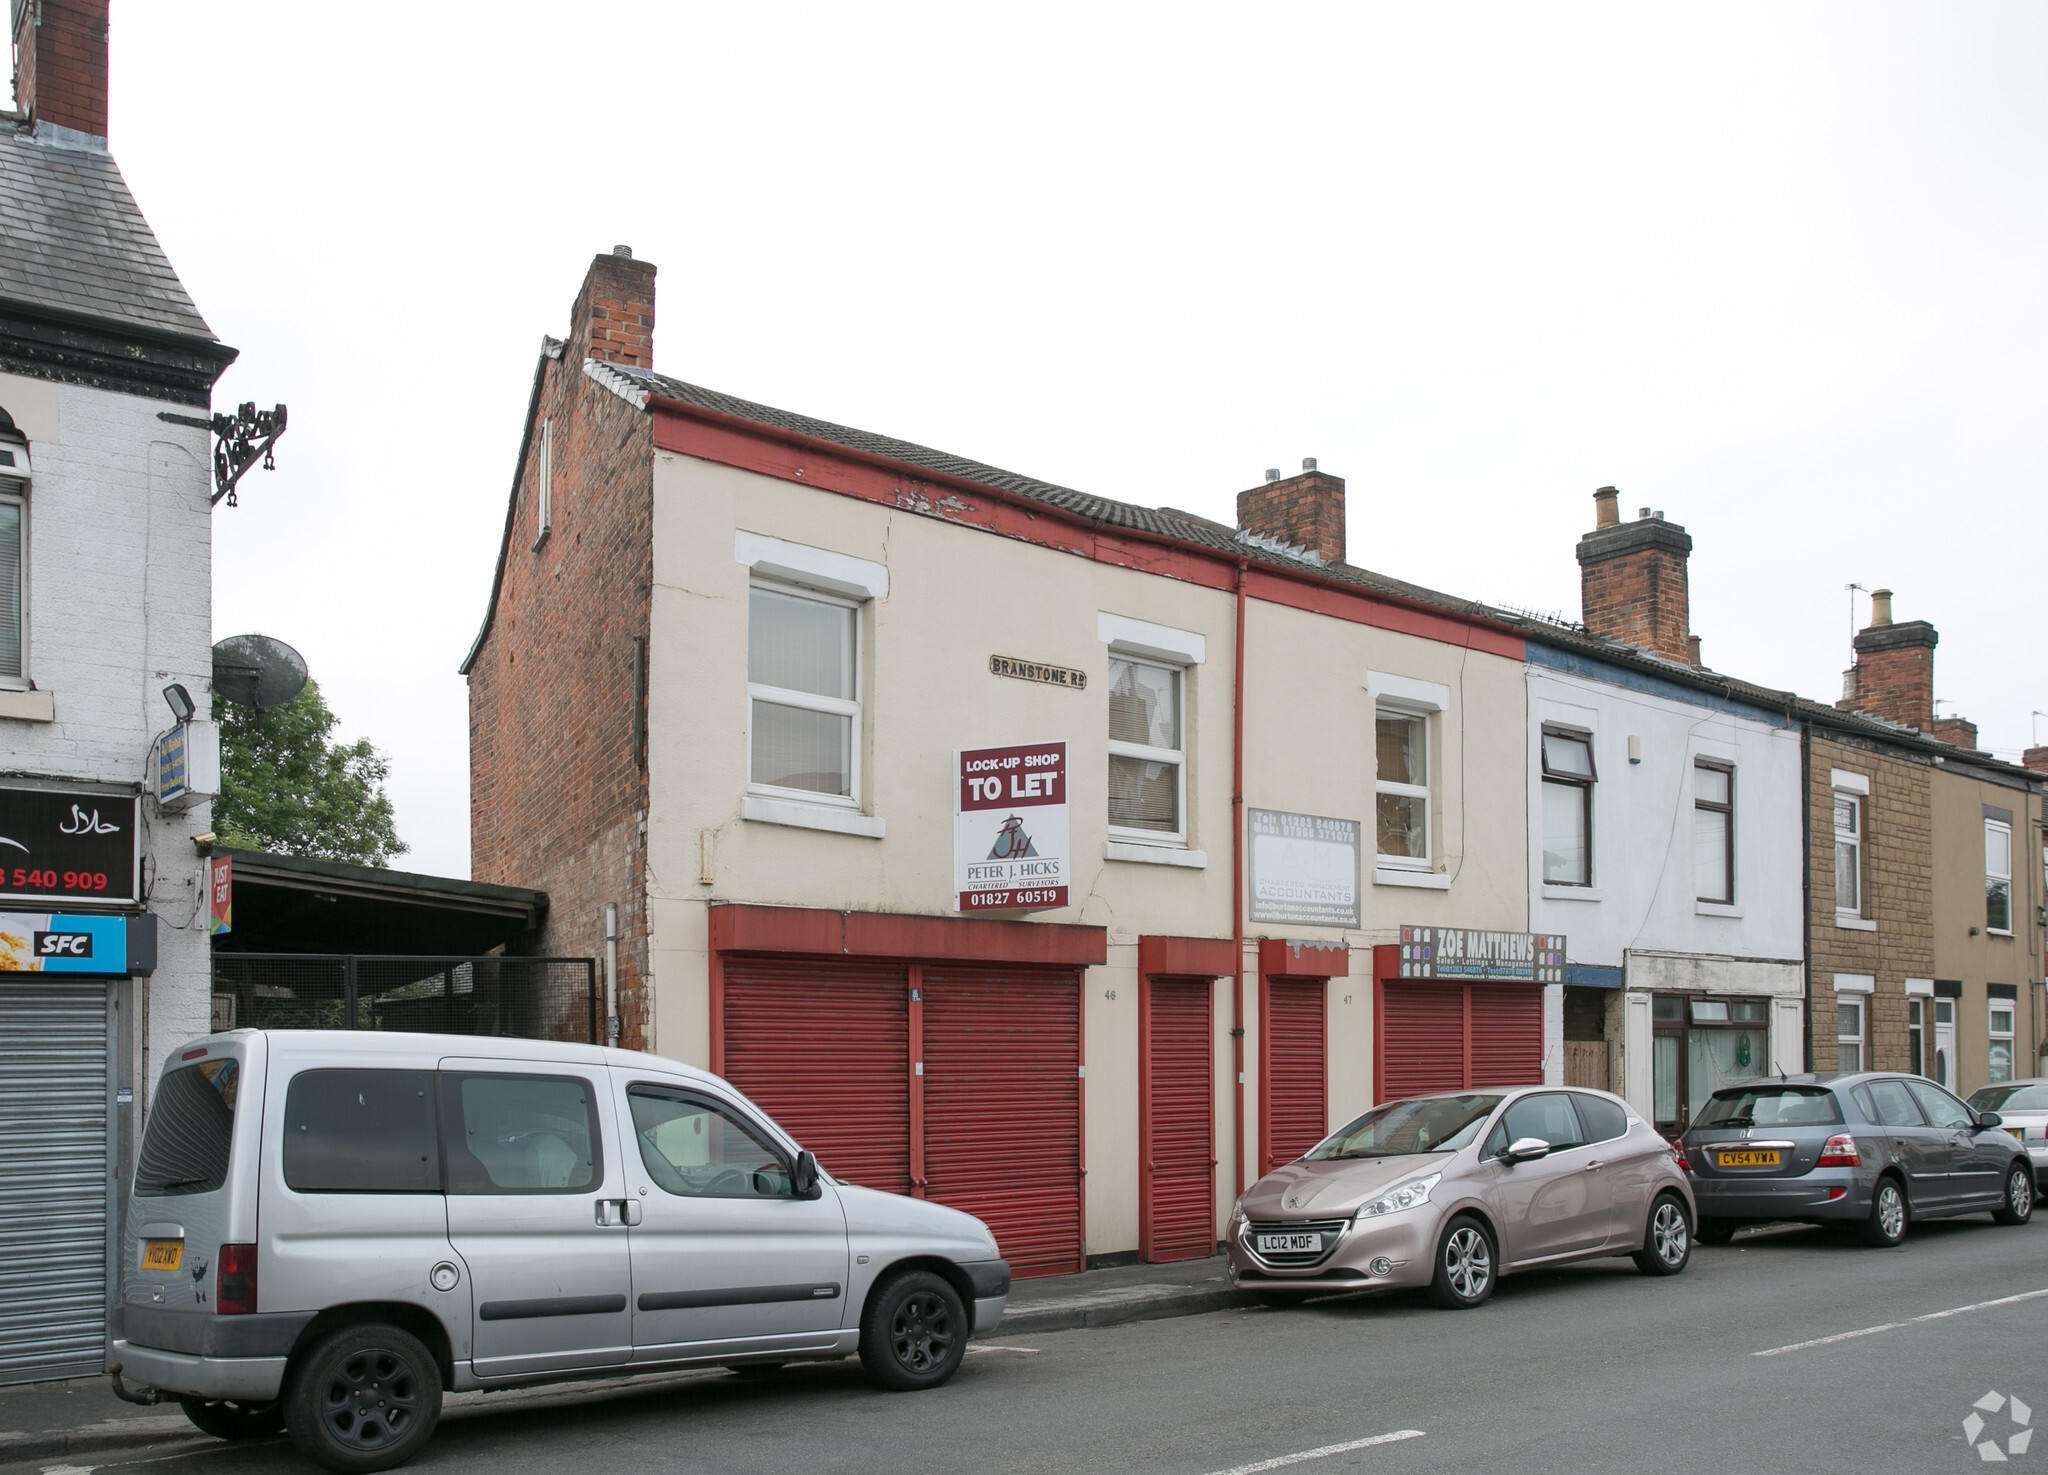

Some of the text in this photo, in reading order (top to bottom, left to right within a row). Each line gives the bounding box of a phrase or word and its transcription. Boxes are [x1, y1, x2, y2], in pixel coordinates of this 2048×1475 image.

[992, 659, 1066, 683] BRANSTONE
[966, 753, 1060, 772] LOCK-UP SHOP
[968, 771, 1058, 801] TO LET
[59, 804, 121, 834] حلال
[1255, 812, 1277, 825] Tel:
[1253, 822, 1279, 834] Mob:
[213, 864, 228, 888] JUST
[968, 862, 1060, 879] PETER J. HICKS
[12, 869, 57, 888] 540
[63, 872, 107, 890] 909
[968, 880, 1059, 891] CHARTERED SURVEYORS
[1259, 878, 1351, 892] CHARTERED MANAGEMENT
[216, 884, 228, 904] EAT
[971, 890, 1056, 906] 01827 60519
[1259, 886, 1352, 902] ACCOUNTANTS
[1255, 901, 1354, 915] info@burtonaccountants.co.uk
[40, 935, 88, 954] SFC
[1437, 929, 1534, 961] ZOE MATTHEWS
[1436, 956, 1534, 969] Sales Lettings Management
[1105, 990, 1116, 1000] 46
[1343, 995, 1353, 1005] 47
[1723, 1151, 1775, 1164] CV54 VWA
[1263, 1235, 1313, 1249] LC12 MDF
